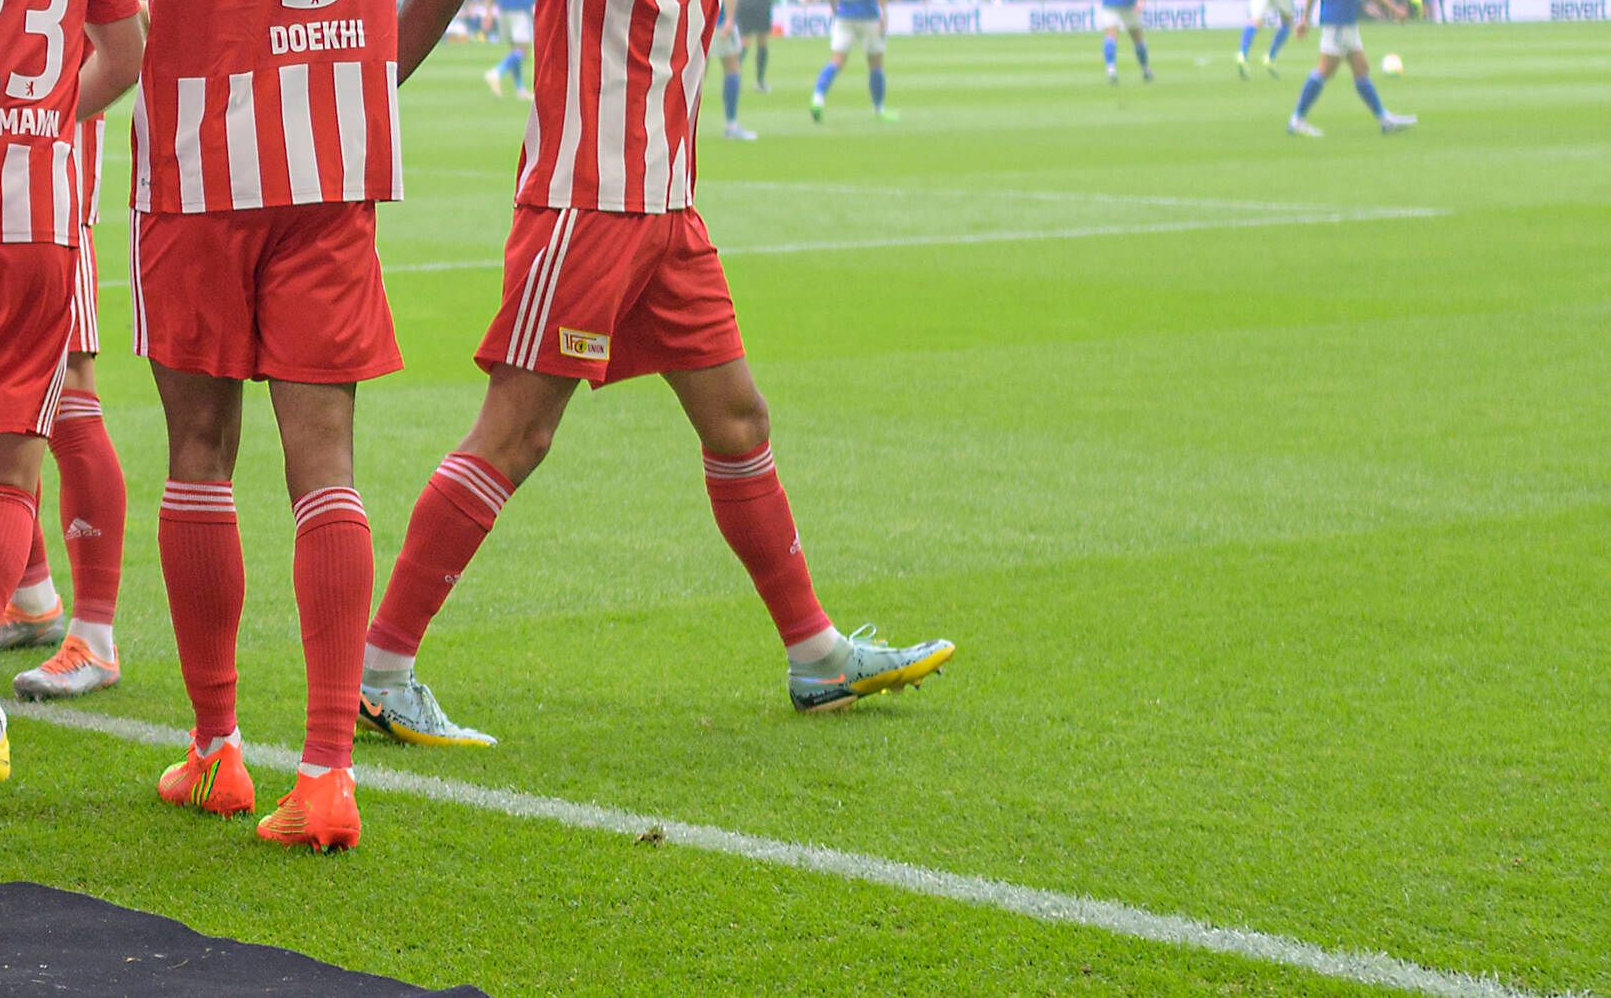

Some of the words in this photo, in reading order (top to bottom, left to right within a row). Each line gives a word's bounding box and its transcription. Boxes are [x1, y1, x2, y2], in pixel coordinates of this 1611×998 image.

[790, 11, 833, 35] siev
[911, 6, 981, 32] sievert
[1029, 5, 1096, 31] sievert
[1141, 3, 1207, 29] sievert
[269, 19, 366, 55] DOEKHI
